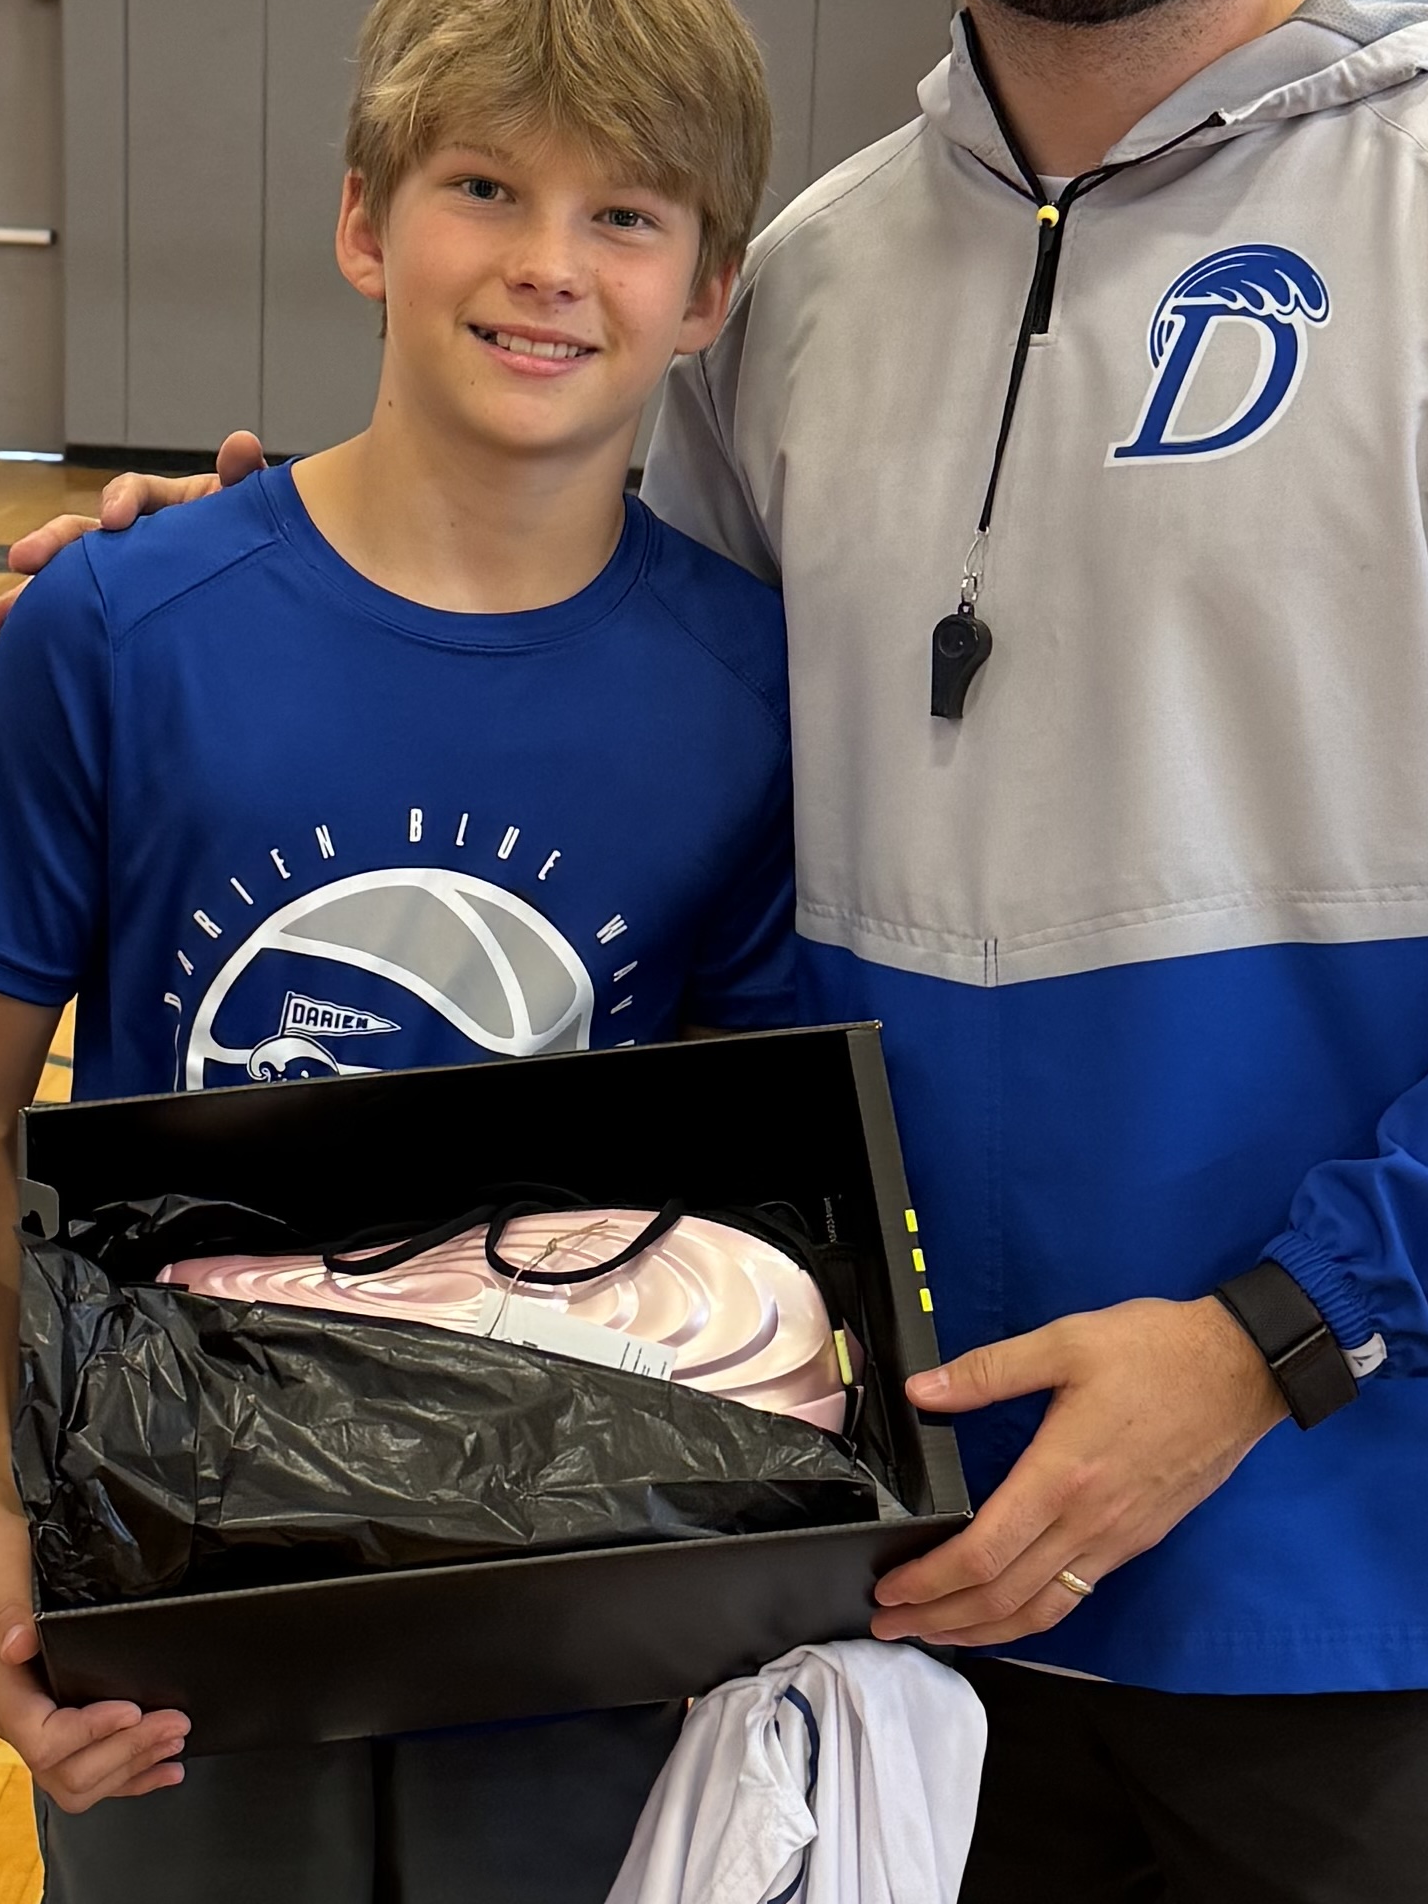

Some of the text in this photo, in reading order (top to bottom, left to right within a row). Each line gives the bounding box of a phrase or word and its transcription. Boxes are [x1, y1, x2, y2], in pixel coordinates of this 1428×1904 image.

[164, 824, 336, 1092] DARIEN
[408, 808, 561, 881] BLUE
[291, 1001, 369, 1031] DARIEN
